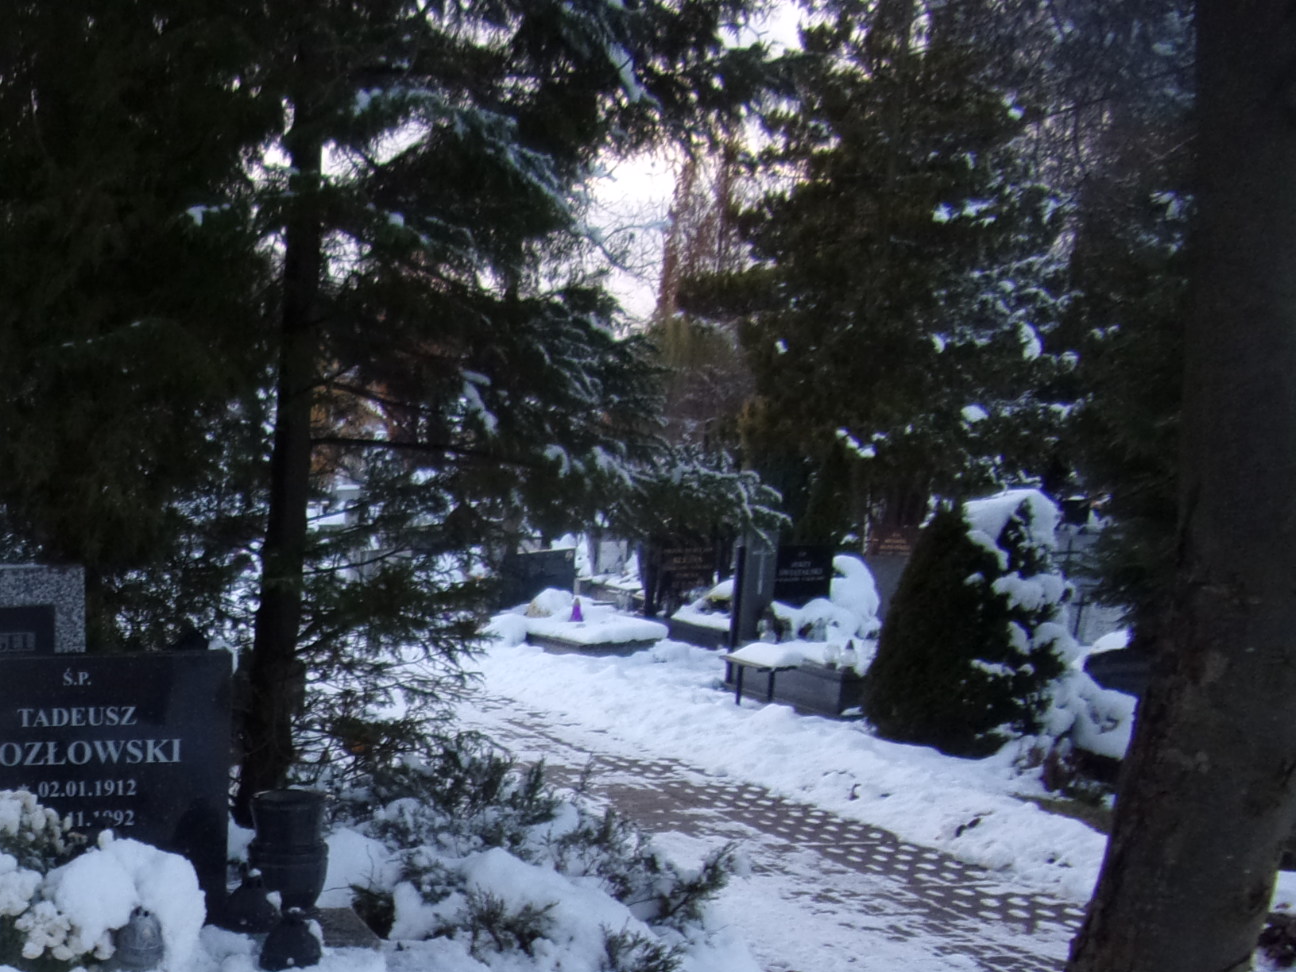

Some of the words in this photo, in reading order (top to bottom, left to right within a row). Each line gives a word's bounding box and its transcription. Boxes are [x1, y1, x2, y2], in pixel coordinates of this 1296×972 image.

[63, 668, 92, 686] Ś.P.
[17, 706, 137, 728] TADEUSZ
[38, 779, 137, 798] 02.01.1912
